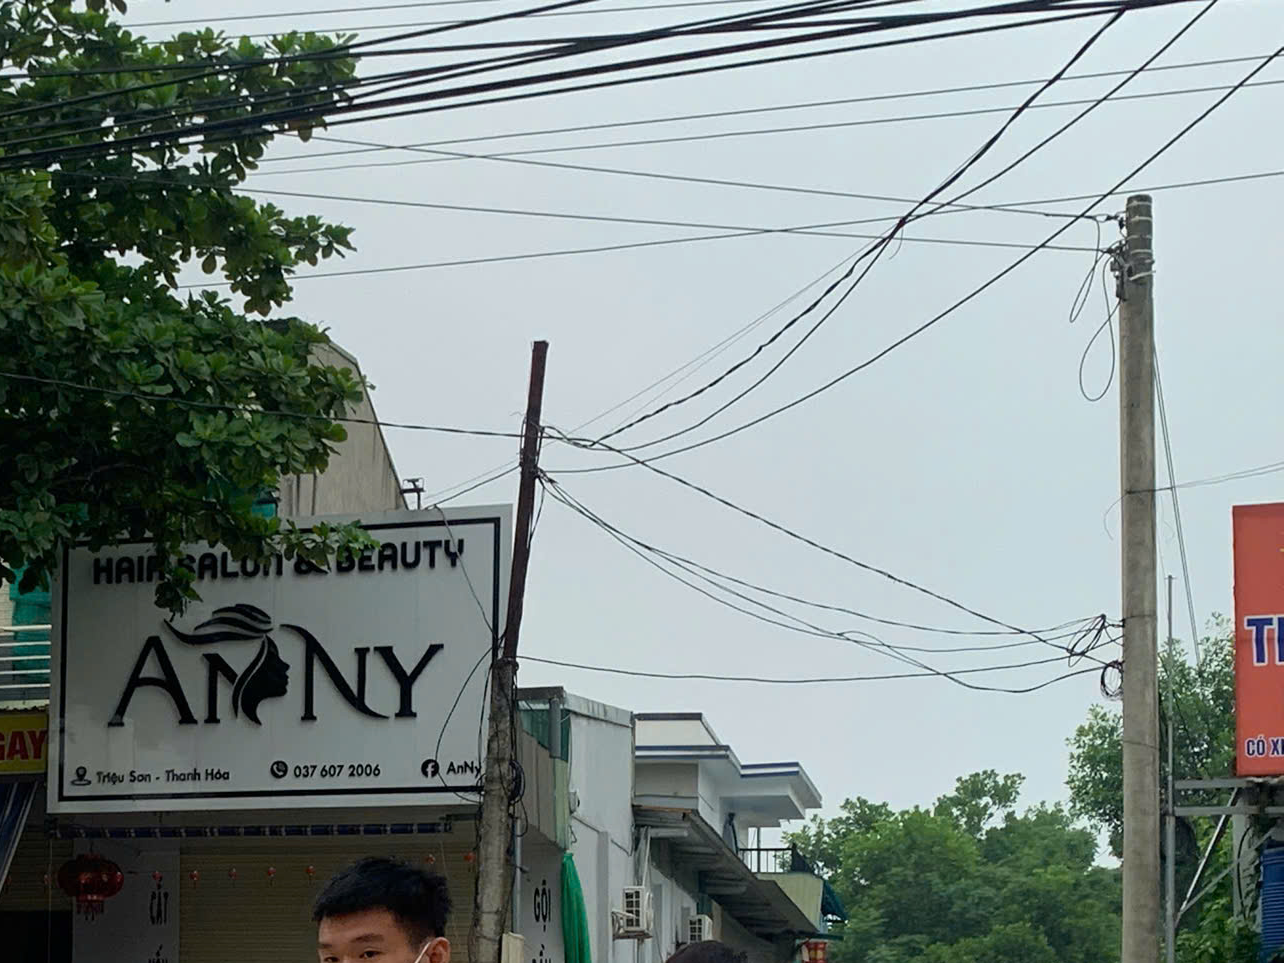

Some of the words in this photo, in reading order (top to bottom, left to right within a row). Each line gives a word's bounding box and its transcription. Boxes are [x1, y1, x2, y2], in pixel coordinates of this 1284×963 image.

[93, 555, 166, 584] HAIR
[336, 539, 464, 574] BEAUTY
[1244, 615, 1284, 665] T
[1246, 735, 1267, 757] CÓ
[96, 770, 124, 786] Triệu
[165, 768, 201, 782] Thanh
[294, 765, 317, 778] 037
[320, 764, 344, 777] 607
[348, 763, 381, 777] 2006
[533, 878, 552, 932] GỘI
